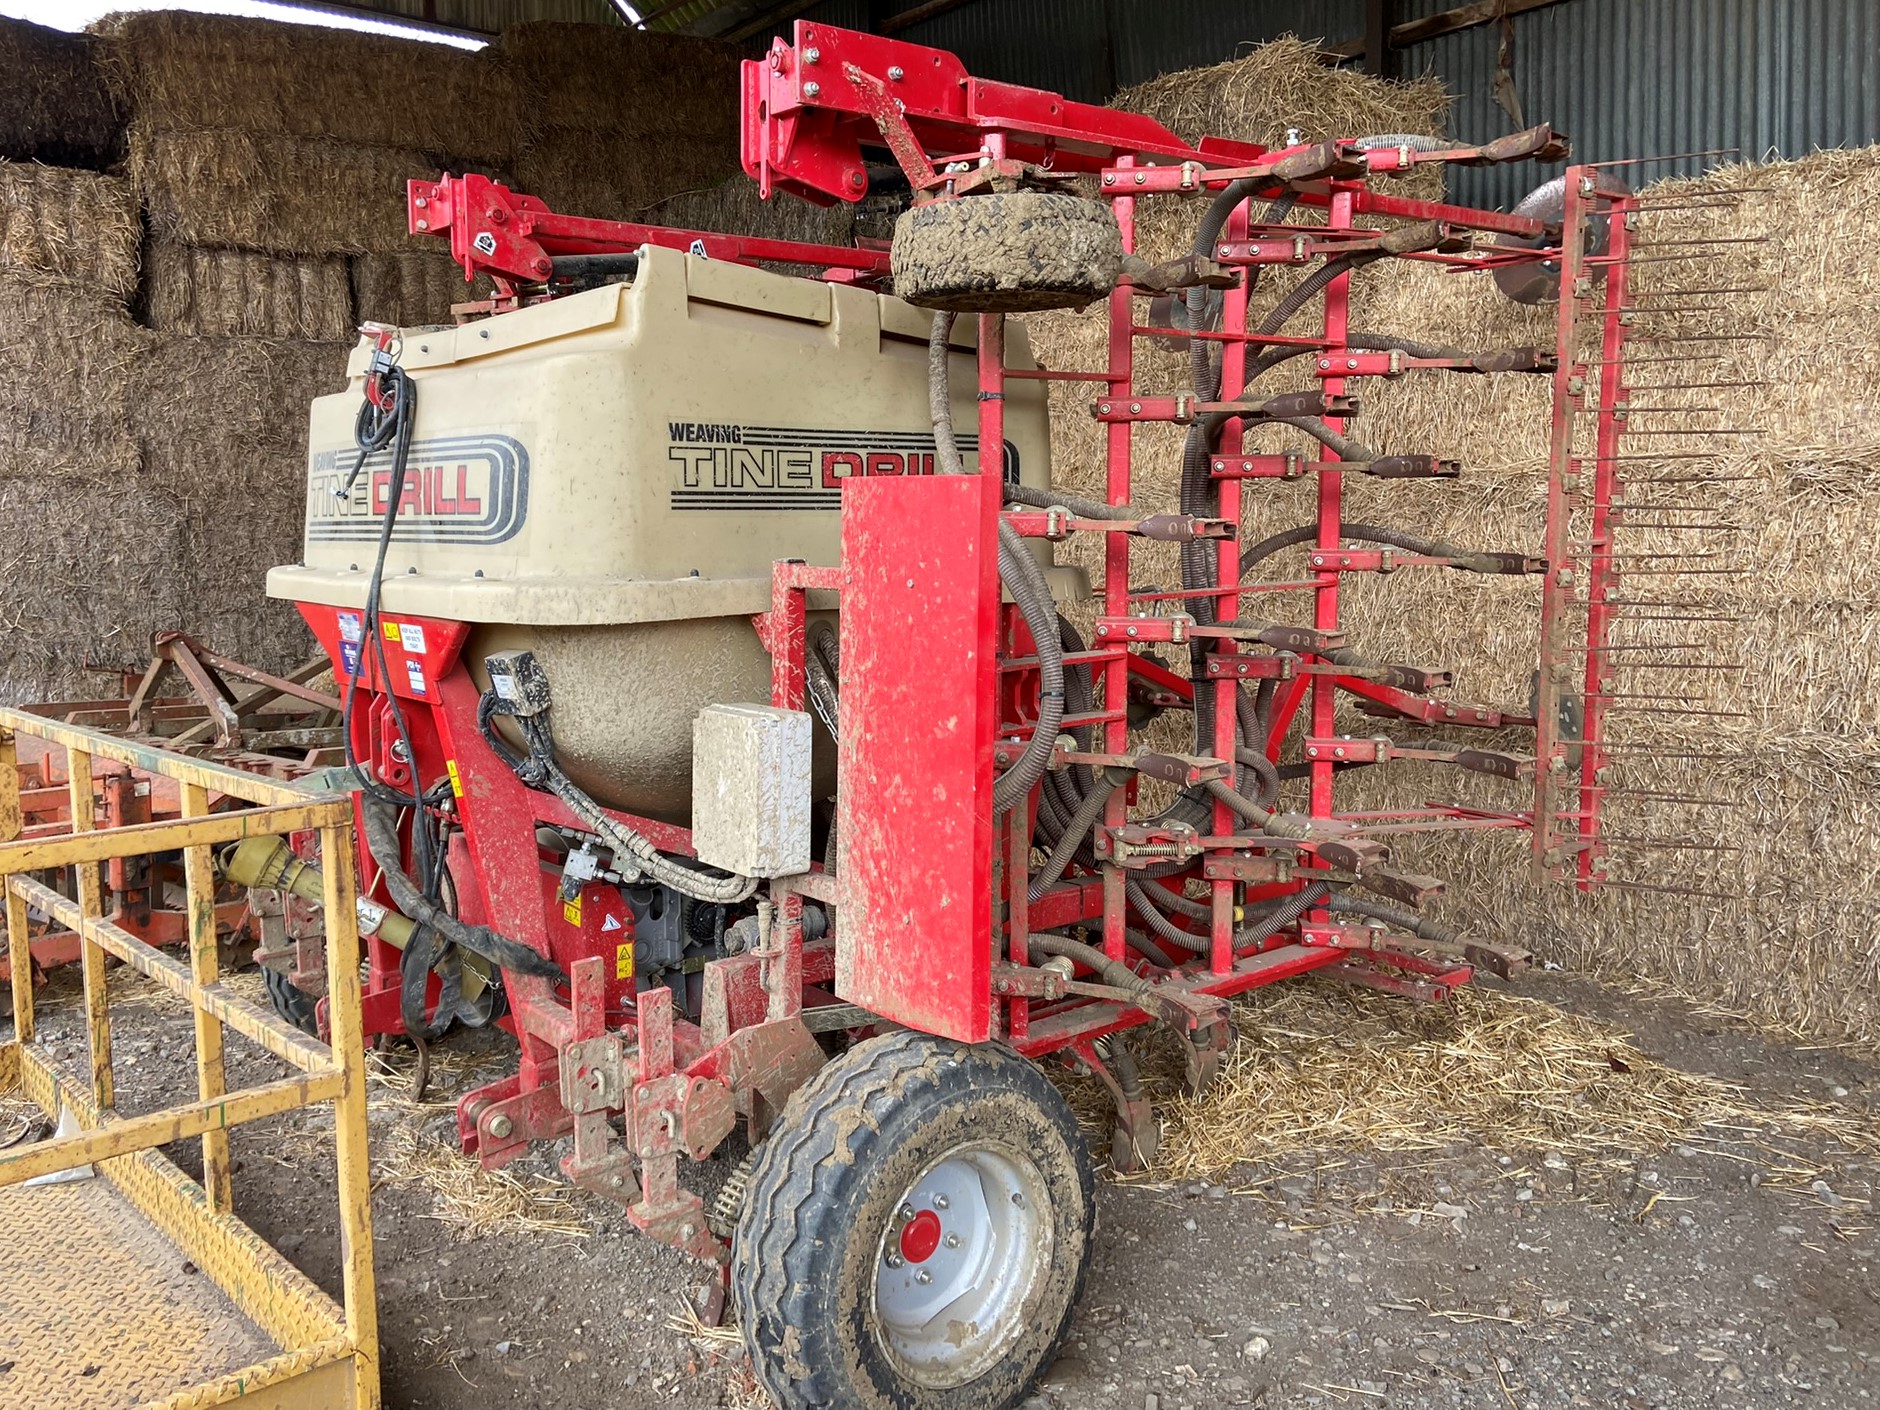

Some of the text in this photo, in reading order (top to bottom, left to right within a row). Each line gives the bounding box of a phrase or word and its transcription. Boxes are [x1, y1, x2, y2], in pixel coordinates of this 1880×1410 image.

[669, 422, 741, 444] WEAVING
[669, 446, 813, 489] TINE
[373, 465, 481, 515] DRILL
